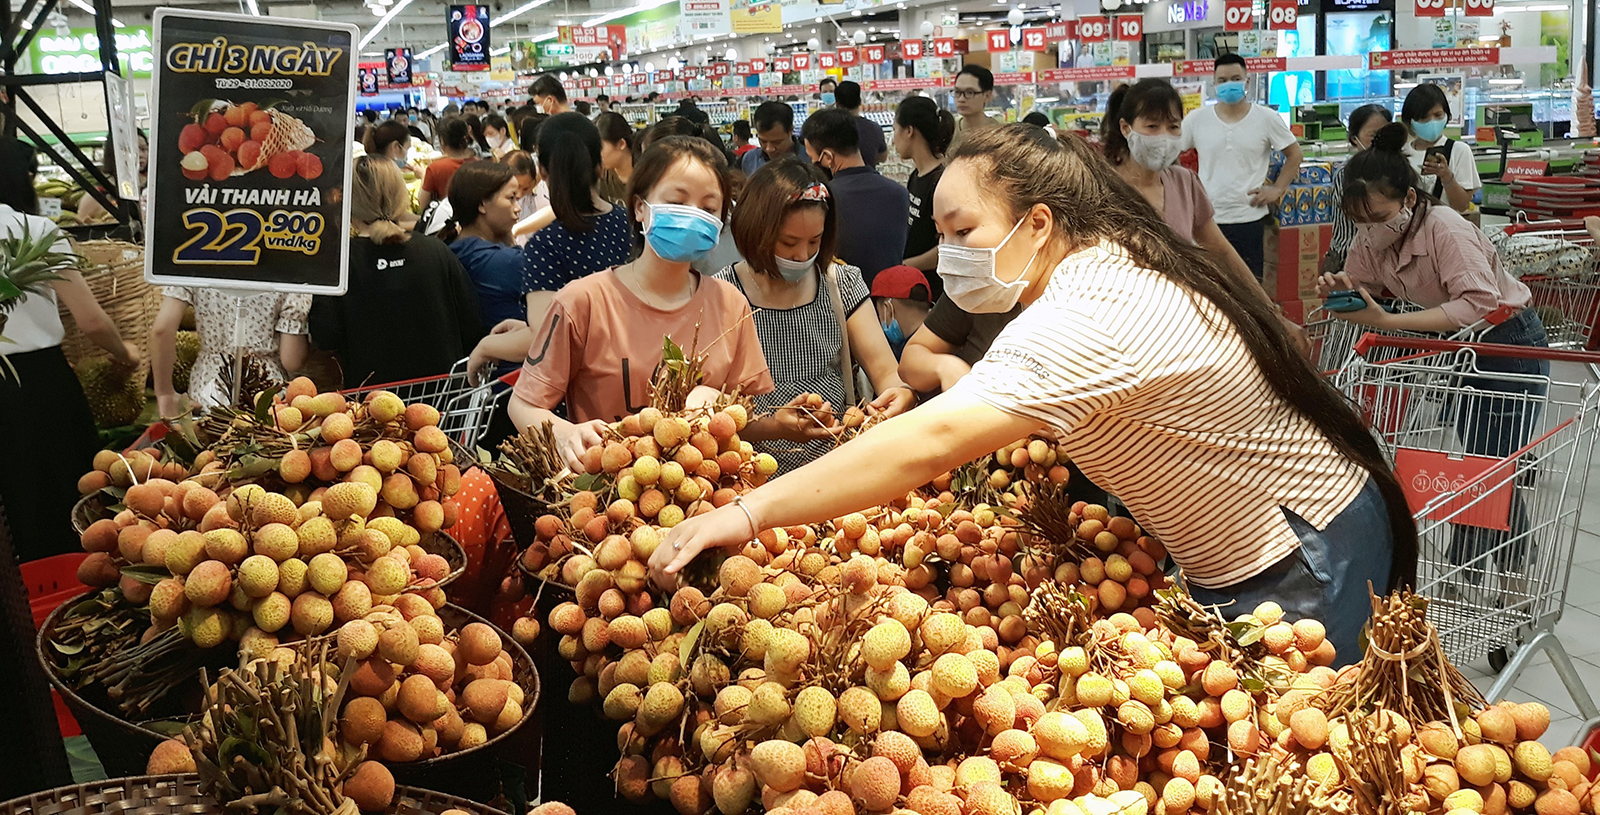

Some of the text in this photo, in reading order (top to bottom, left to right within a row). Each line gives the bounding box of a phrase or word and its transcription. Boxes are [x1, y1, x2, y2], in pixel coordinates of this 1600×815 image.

[1227, 7, 1251, 24] 07
[1272, 7, 1296, 24] 08
[1082, 22, 1103, 37] 09
[1121, 22, 1140, 36] 10
[991, 34, 1005, 48] 11
[1026, 33, 1043, 47] 12
[904, 43, 920, 56] 13
[936, 42, 952, 54] 14
[166, 36, 343, 76] CHỈ 3 NGÀY
[840, 50, 853, 62] 15
[868, 49, 881, 60] 16
[752, 61, 764, 71] 19
[776, 61, 790, 71] 20
[795, 56, 808, 67] 17
[821, 56, 834, 67] 18
[715, 65, 726, 74] 21
[737, 65, 750, 74] 22
[185, 183, 322, 207] VẢI THANH HÀ
